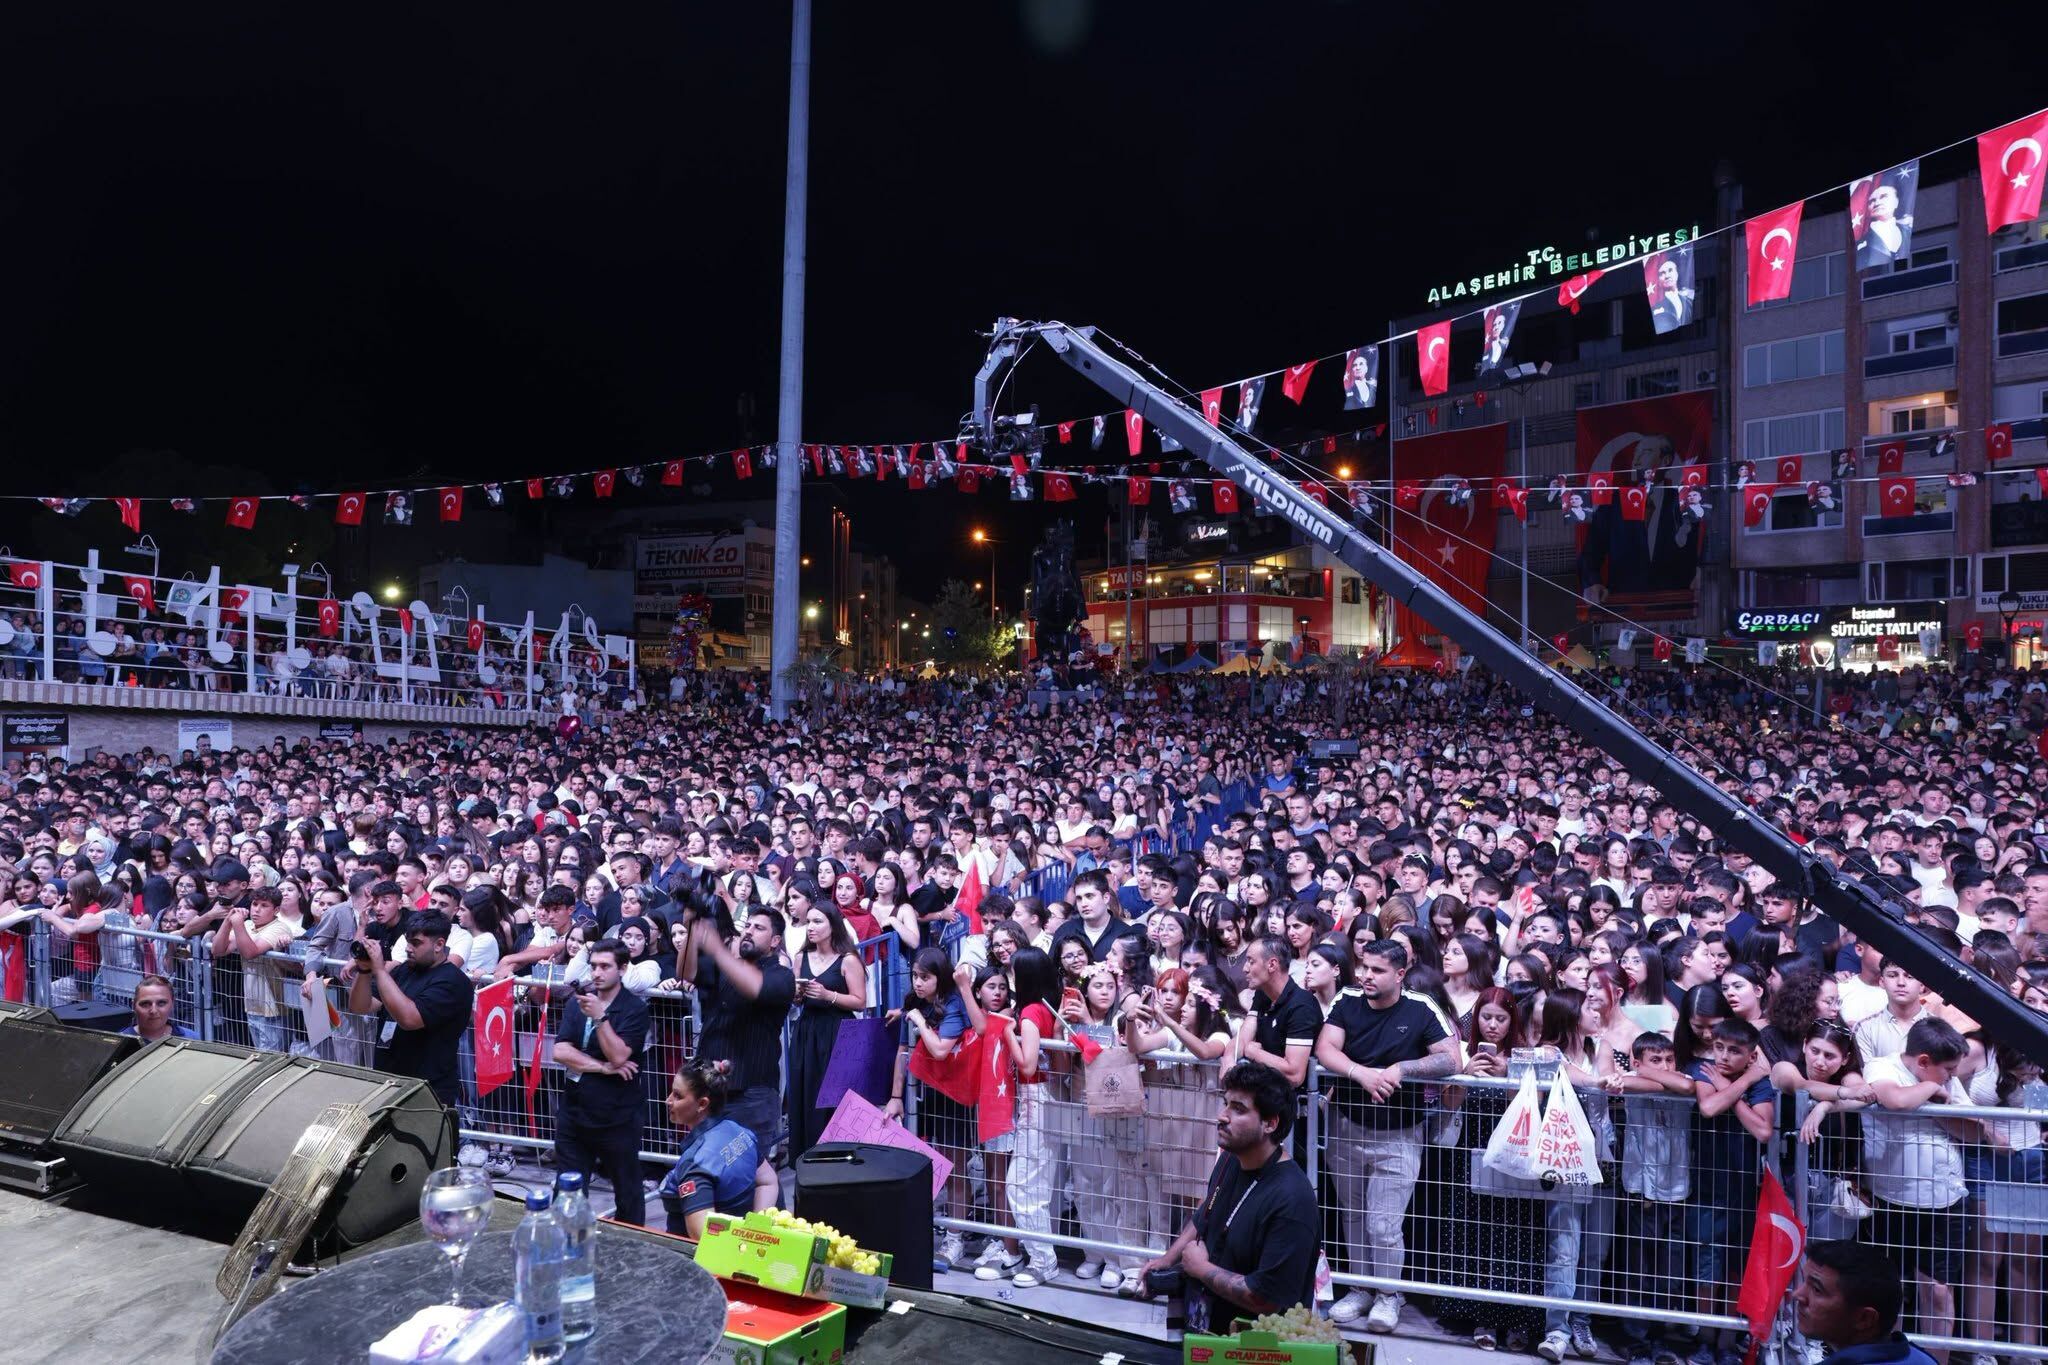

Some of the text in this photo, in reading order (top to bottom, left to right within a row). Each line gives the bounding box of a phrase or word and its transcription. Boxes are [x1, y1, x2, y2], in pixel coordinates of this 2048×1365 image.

[1527, 246, 1562, 265] T.C.
[1427, 262, 1536, 303] ALAŞEHİR
[712, 546, 738, 563] 20
[1738, 612, 1820, 631] ÇORBACI
[1851, 607, 1896, 620] İstanbul
[1830, 621, 1884, 638] SÜTLÜCE
